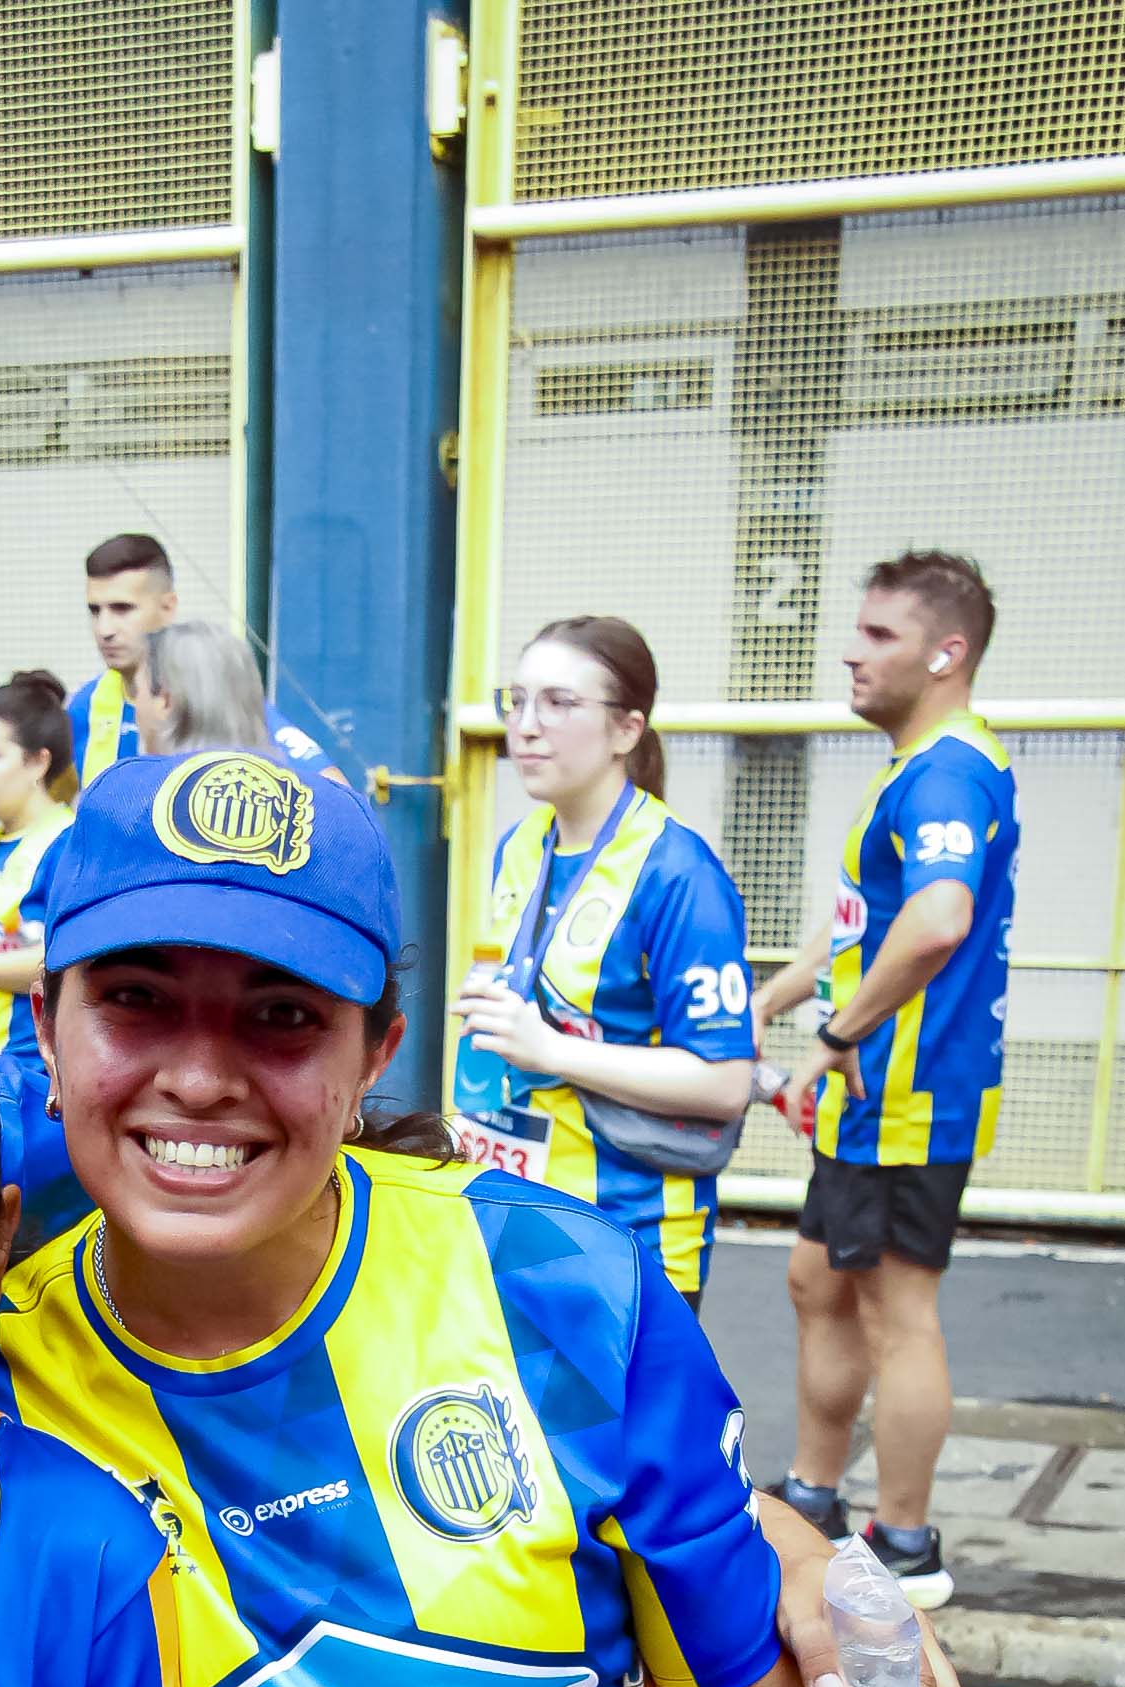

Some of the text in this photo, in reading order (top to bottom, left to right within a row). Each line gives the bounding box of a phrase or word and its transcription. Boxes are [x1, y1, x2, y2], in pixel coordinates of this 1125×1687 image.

[207, 783, 269, 807] CARC
[915, 819, 975, 862] 30
[683, 961, 748, 1019] 30
[428, 1431, 484, 1463] CARC
[254, 1479, 350, 1522] express
